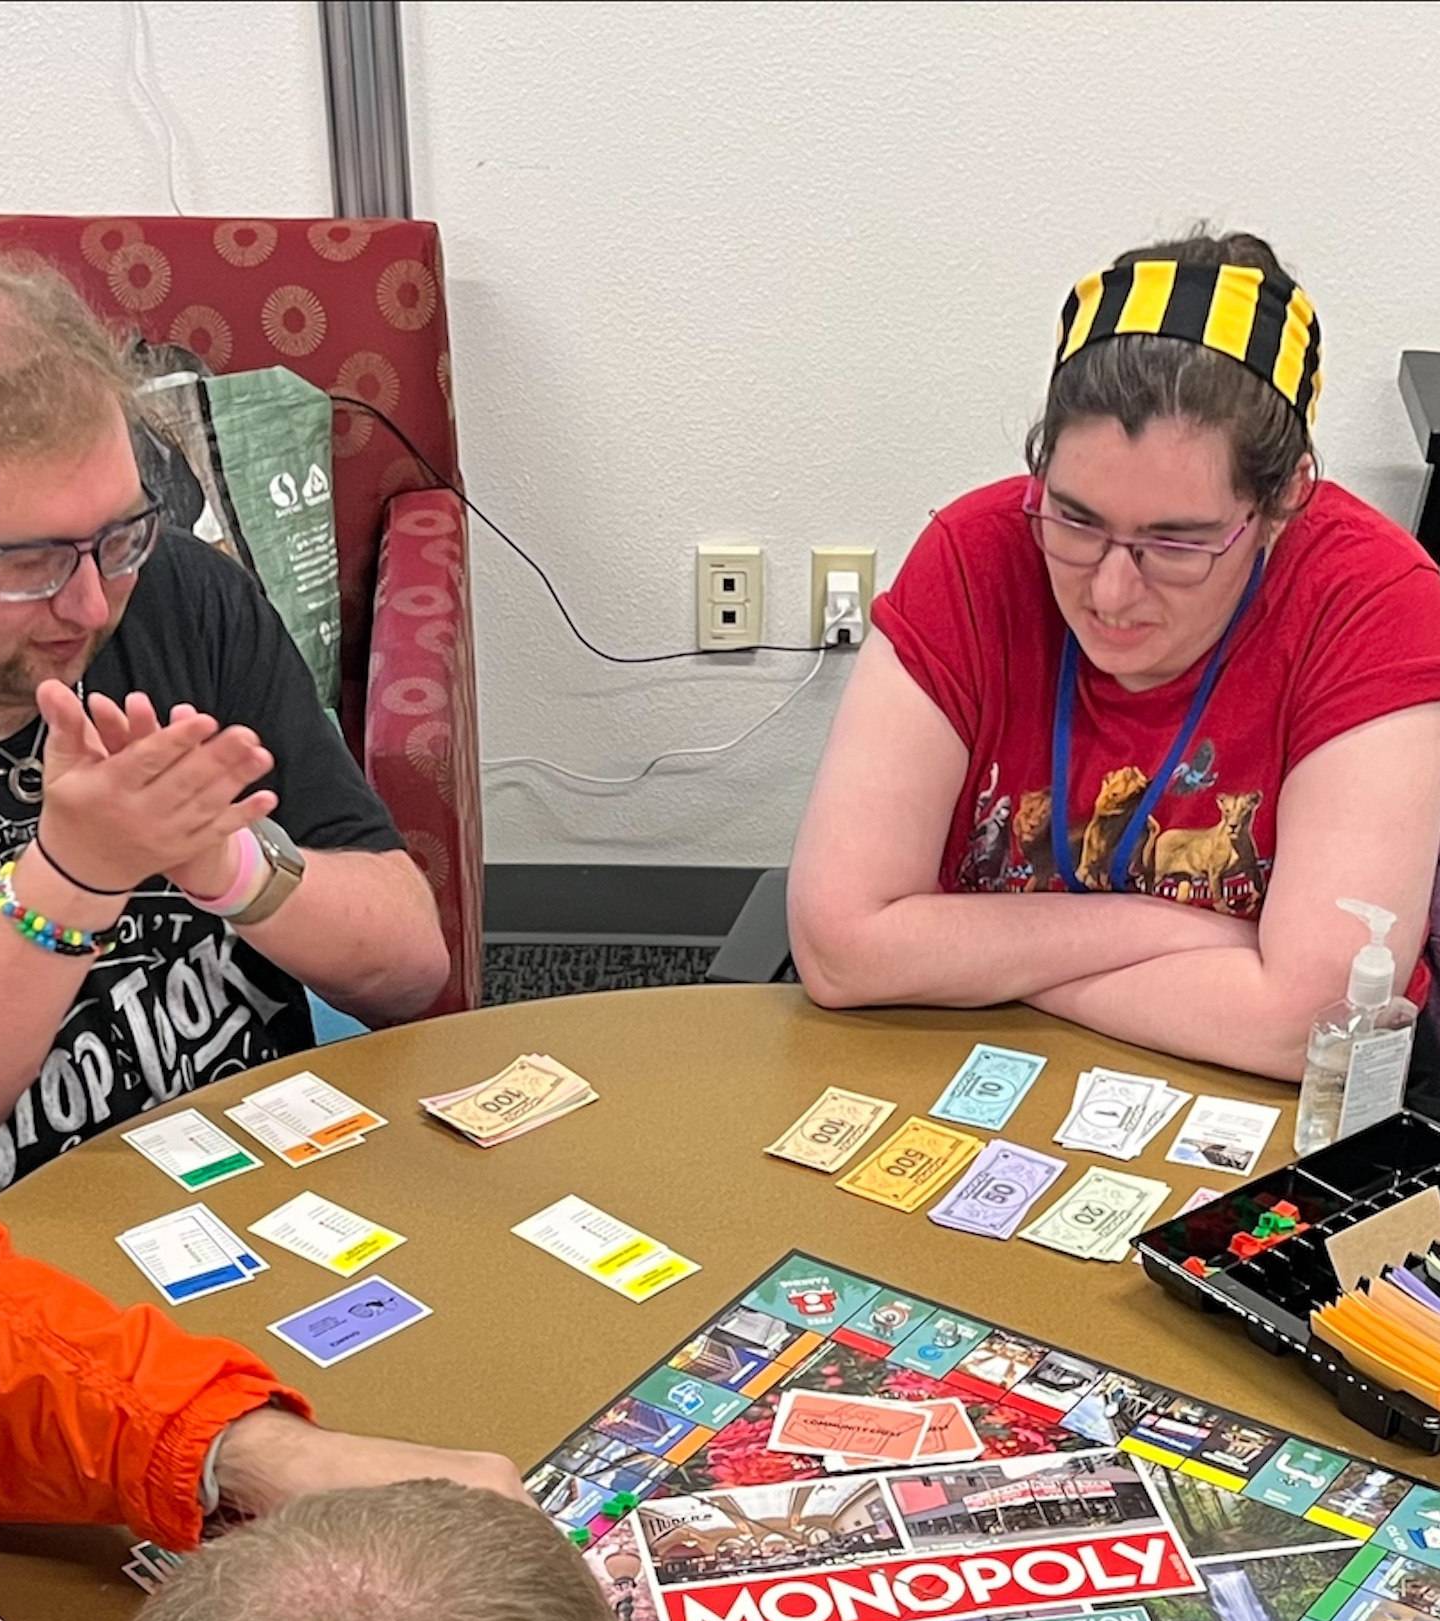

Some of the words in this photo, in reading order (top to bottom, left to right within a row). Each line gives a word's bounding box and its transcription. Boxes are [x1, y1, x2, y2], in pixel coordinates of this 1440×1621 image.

[976, 1081, 1003, 1098] 10
[482, 1089, 522, 1113] 100
[811, 1118, 844, 1144] 100
[886, 1149, 925, 1177] 500
[986, 1183, 1016, 1204] 50
[1074, 1206, 1104, 1225] 20
[803, 1419, 868, 1433] COMMUNITY
